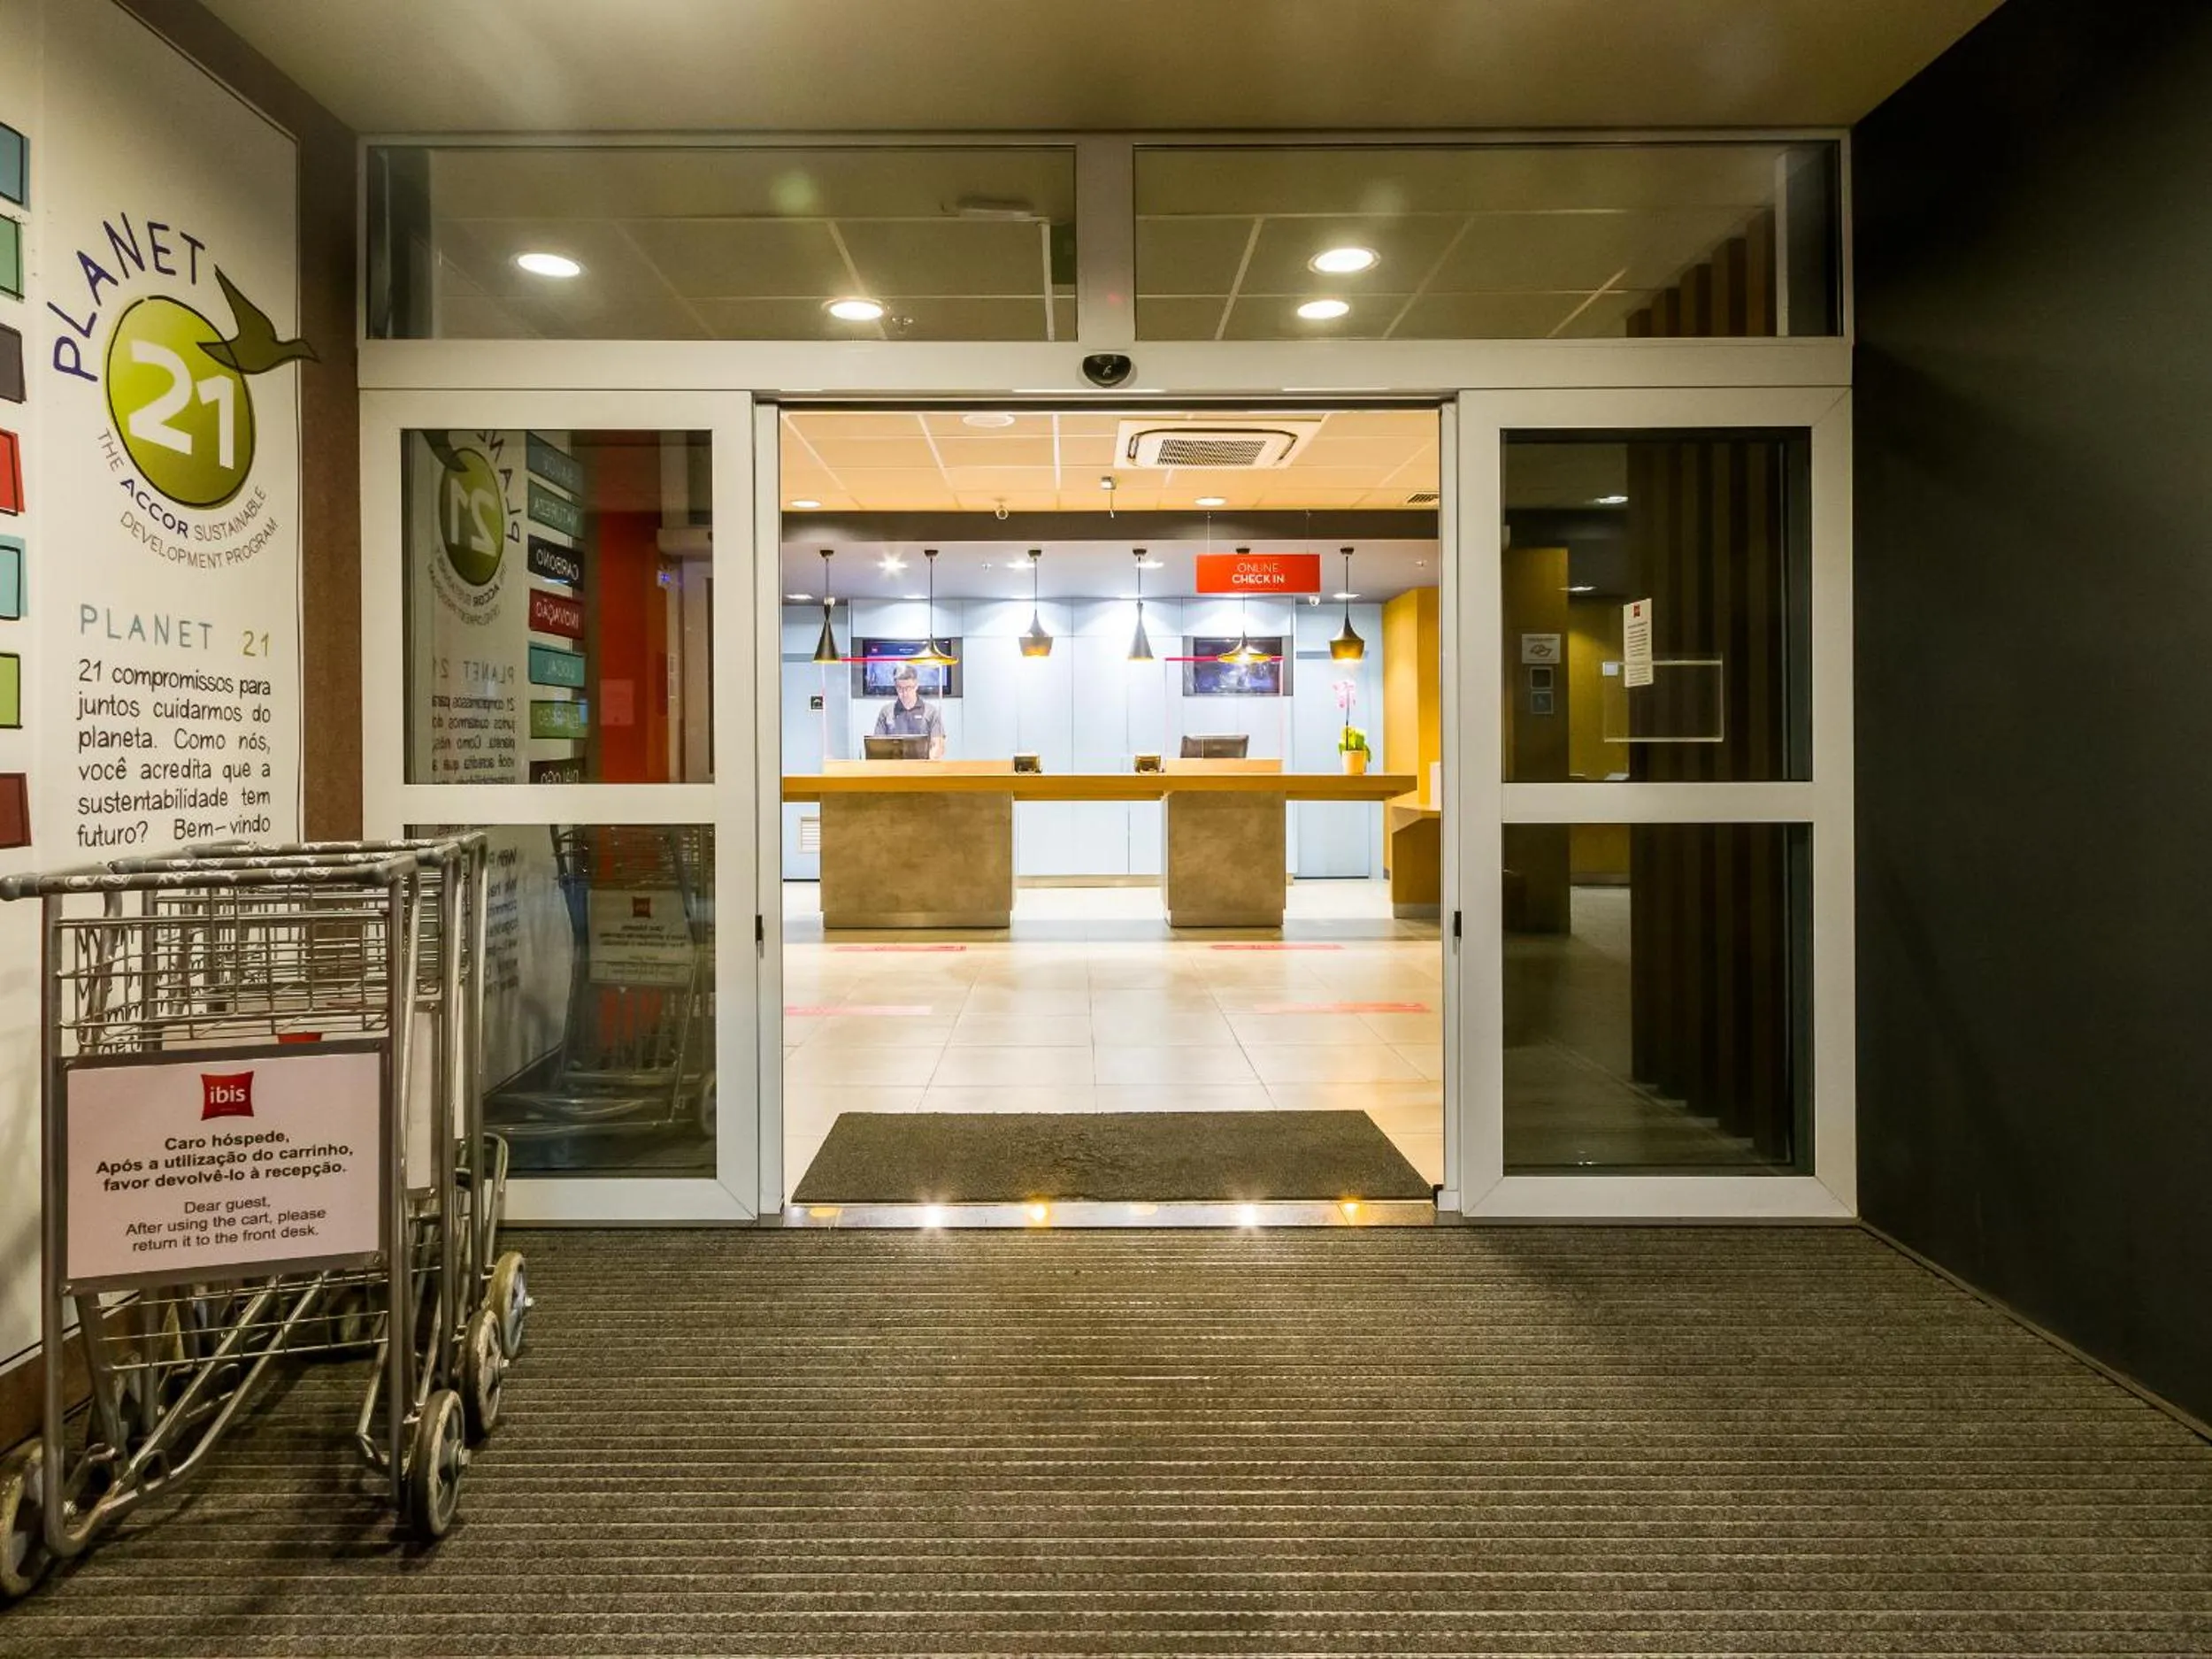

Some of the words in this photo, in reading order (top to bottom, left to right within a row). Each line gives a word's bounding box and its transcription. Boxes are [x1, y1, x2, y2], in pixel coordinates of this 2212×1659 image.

[47, 211, 205, 382] PLANET
[128, 340, 234, 470] 21
[96, 427, 125, 472] THE
[120, 478, 189, 539] ACCOR
[194, 487, 266, 541] SUSTAINABLE
[120, 511, 224, 570] DEVELOPMENT
[225, 517, 279, 566] PROGRAM
[1232, 574, 1271, 584] CHECK
[1273, 574, 1286, 584] IN
[1237, 563, 1279, 573] ONLINE
[80, 603, 213, 649] PLANET
[242, 630, 270, 657] 21
[79, 658, 102, 682] 21
[112, 665, 234, 694] compromissos
[239, 677, 272, 699] para
[76, 691, 141, 720] juntos
[152, 697, 243, 723] cuidarmos
[252, 703, 272, 724] do
[78, 726, 158, 754] planeta.
[173, 727, 227, 750] Como
[238, 732, 272, 755] nós,
[78, 757, 127, 781] você
[140, 758, 212, 780] acredita
[222, 762, 251, 784] que
[261, 763, 271, 778] a
[77, 787, 229, 815] sustentabilidade
[241, 787, 271, 807] tem
[76, 820, 149, 848] futuro?
[173, 814, 271, 841] Bem-vindo
[209, 1084, 247, 1104] ibis
[165, 1137, 206, 1151] Caro
[211, 1130, 290, 1148] hóspede,
[96, 1158, 142, 1176] Após
[149, 1158, 159, 1171] a
[165, 1151, 247, 1169] utilização
[252, 1147, 274, 1162] do
[280, 1143, 354, 1160] carrinho,
[104, 1175, 150, 1192] favor
[155, 1166, 245, 1187] devolvê-lo
[250, 1165, 260, 1179] à
[265, 1162, 347, 1181] recepção.
[184, 1200, 221, 1214] Dear
[226, 1196, 271, 1213] guest,
[126, 1221, 163, 1236] After
[167, 1218, 208, 1234] using
[213, 1214, 236, 1228] the
[241, 1211, 273, 1226] cart,
[278, 1207, 327, 1225] please
[132, 1237, 178, 1252] return
[182, 1234, 191, 1248] it
[196, 1233, 211, 1247] to
[215, 1230, 238, 1244] the
[242, 1227, 276, 1241] front
[280, 1225, 319, 1239] desk.
